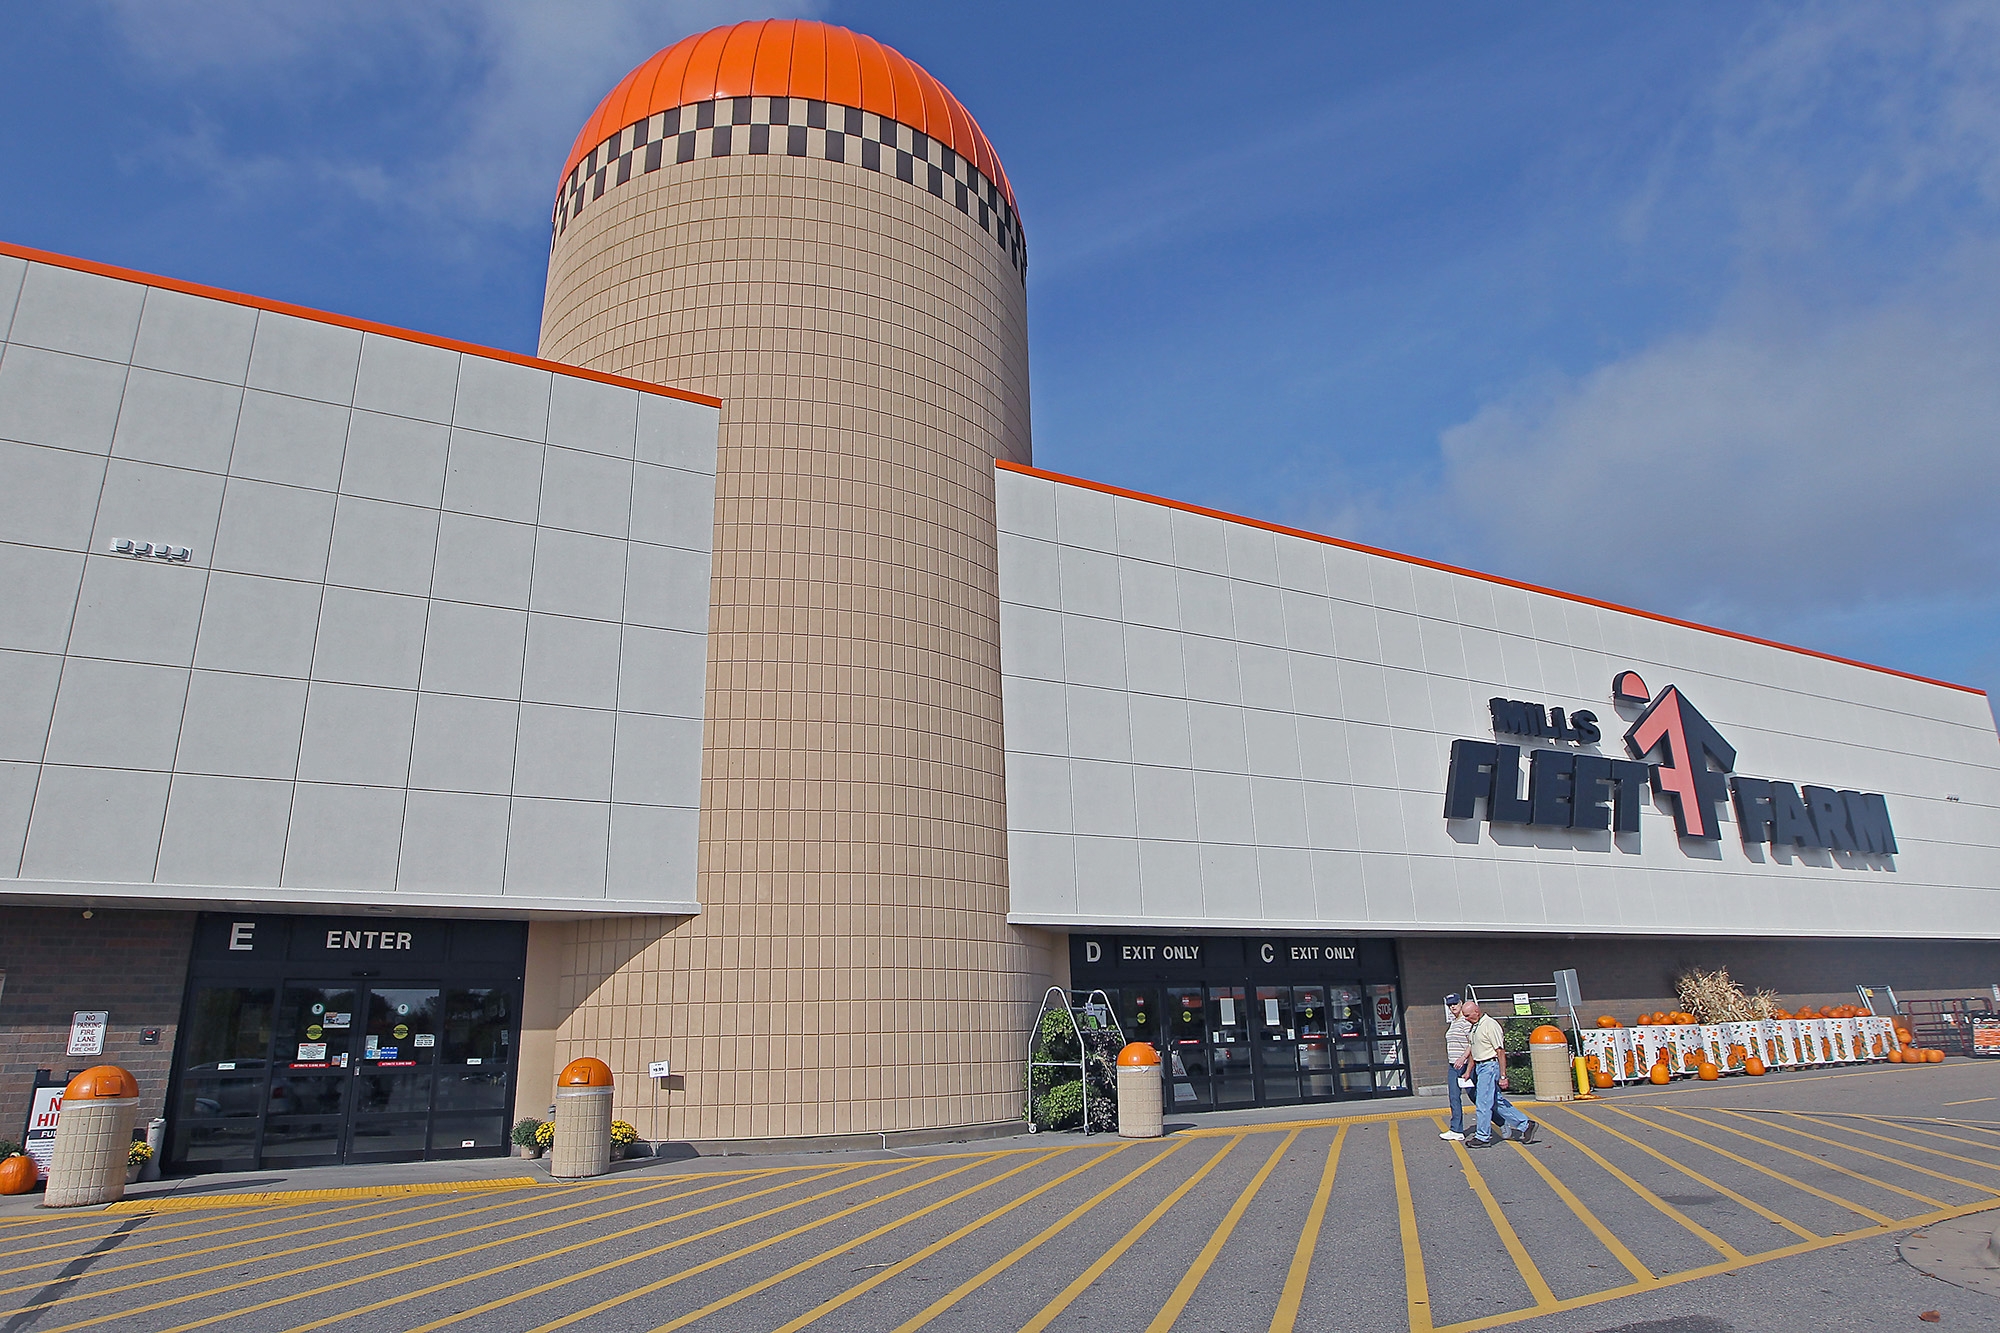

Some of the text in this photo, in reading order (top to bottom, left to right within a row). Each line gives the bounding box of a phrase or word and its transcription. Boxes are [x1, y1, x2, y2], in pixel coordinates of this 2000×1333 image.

[1489, 697, 1601, 744] MILLS
[1444, 739, 1898, 856] FLEET FARM
[229, 922, 256, 951] E
[326, 930, 412, 950] ENTER
[1086, 941, 1101, 962] D
[1122, 945, 1200, 960] EXIT ONLY
[1260, 943, 1274, 963] C
[1291, 946, 1356, 960] EXIT ONLY
[77, 1035, 96, 1043] LANE
